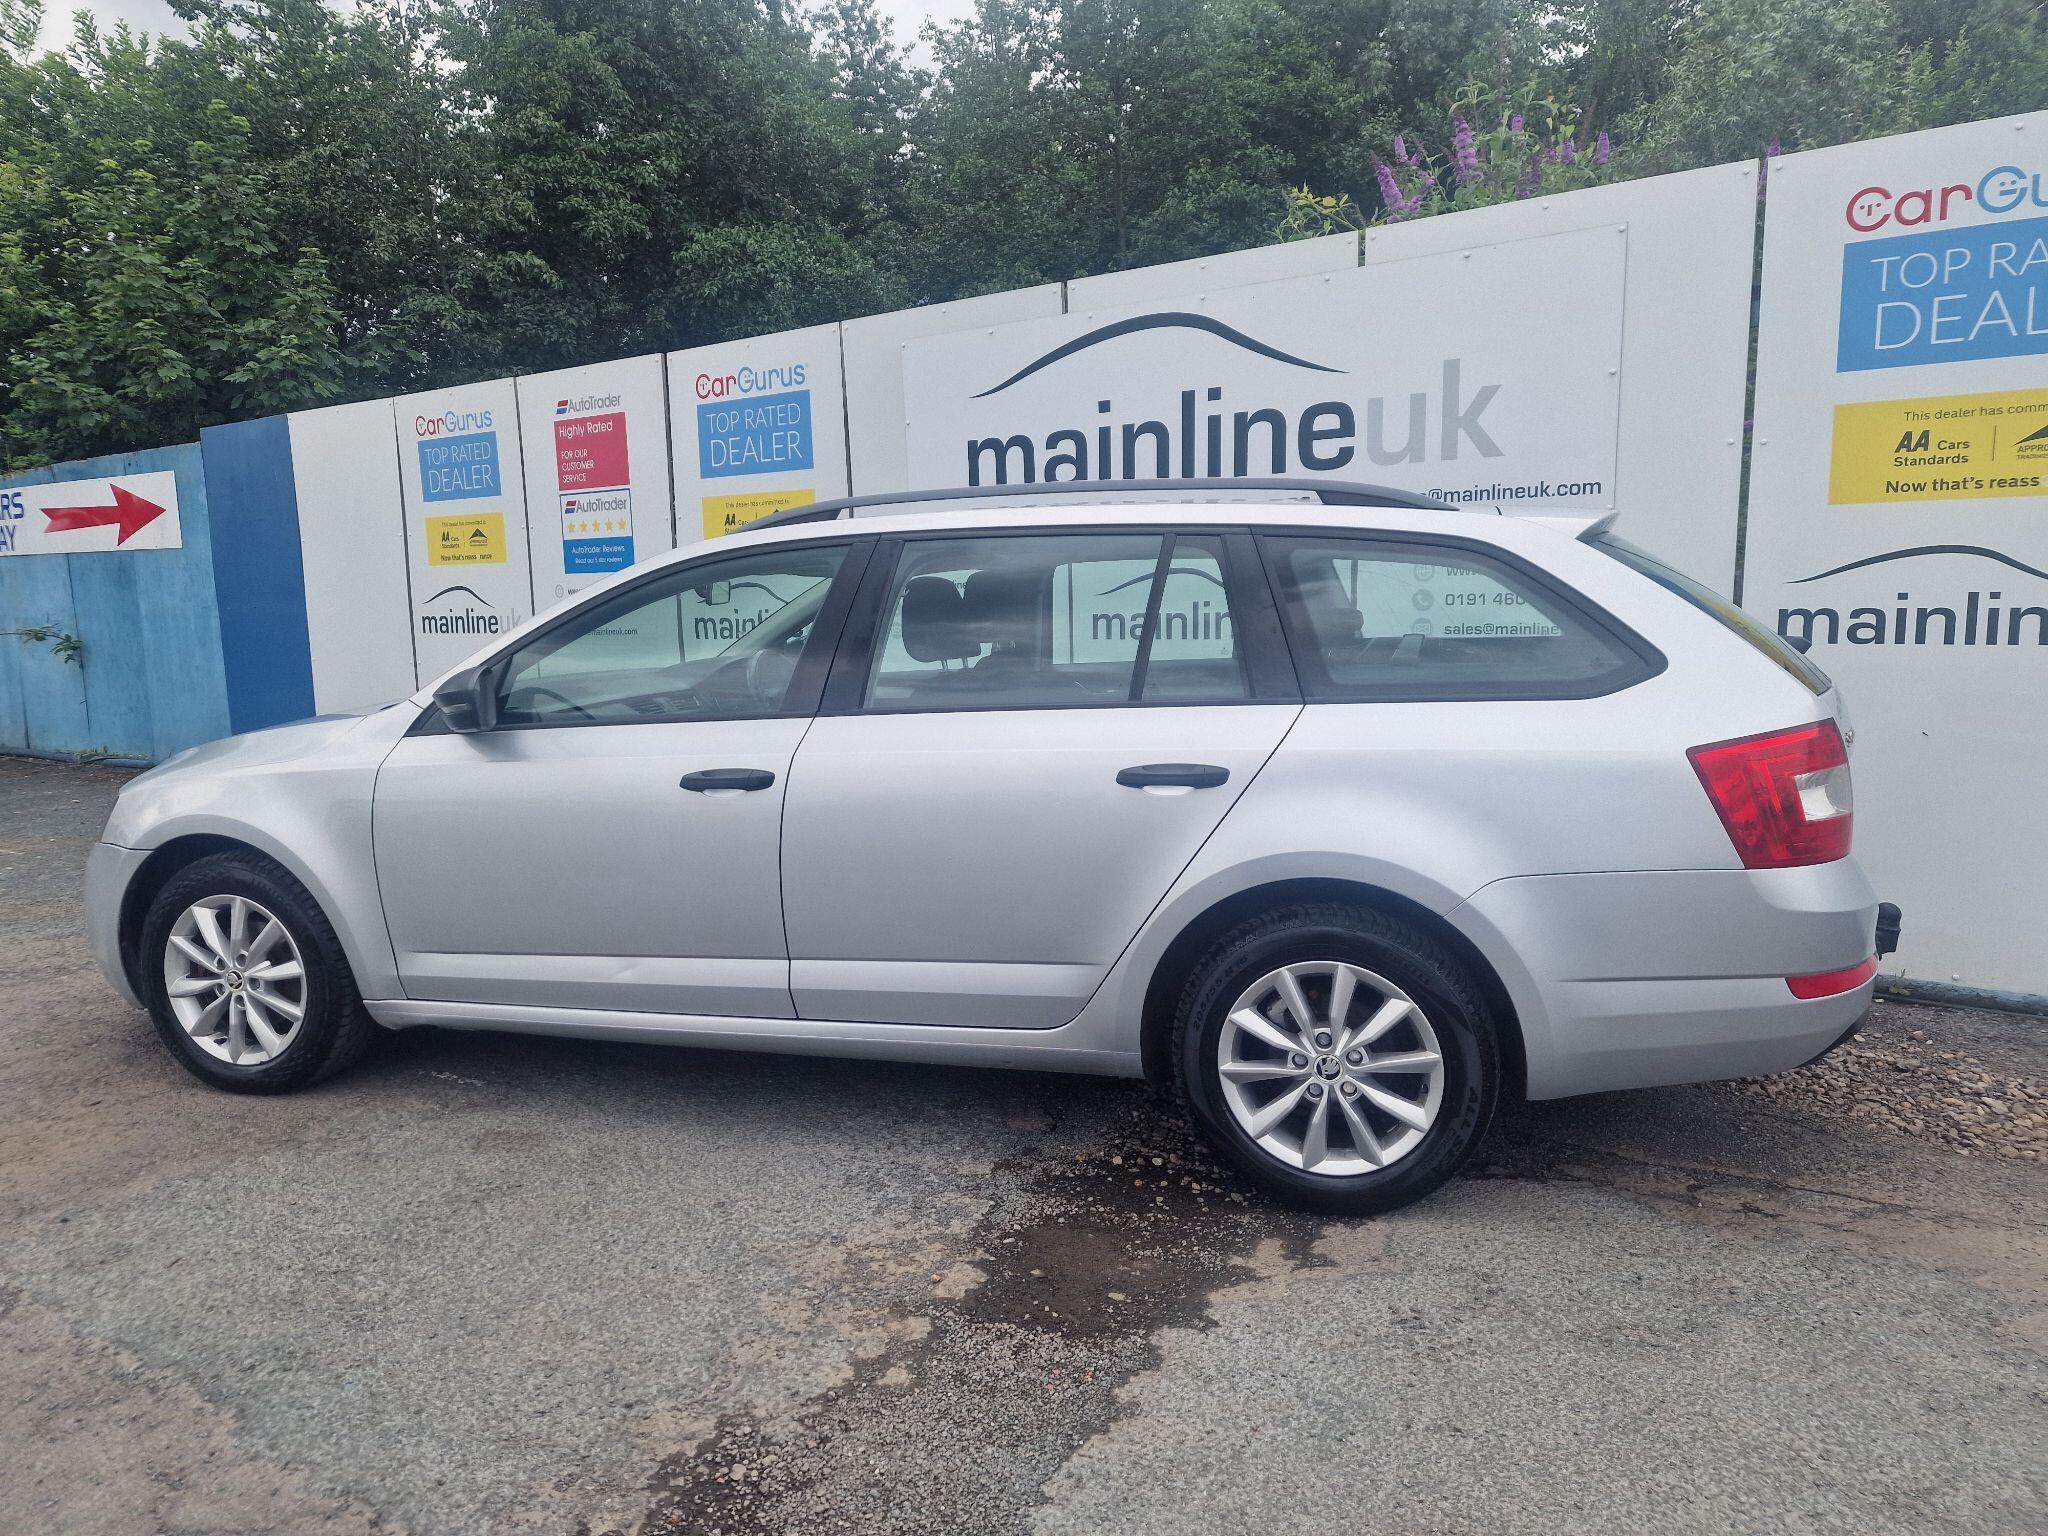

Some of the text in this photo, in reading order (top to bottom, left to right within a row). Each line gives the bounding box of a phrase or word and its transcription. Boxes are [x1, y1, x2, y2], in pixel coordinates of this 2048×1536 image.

[1870, 251, 1972, 293] TOP
[1874, 286, 2048, 350] DEAL
[695, 363, 806, 400] CarGurus
[567, 393, 621, 413] AutoTrader
[1904, 411, 1930, 421] This
[1934, 408, 1976, 420] dealer
[1979, 406, 2003, 416] has
[415, 410, 493, 437] CarGurus
[559, 420, 613, 439] Highly Rated
[706, 403, 801, 434] TOP RATED
[967, 358, 1505, 488] mainlineuk
[424, 442, 491, 465] TOP RATED
[710, 430, 803, 467] DEALER
[1894, 429, 1970, 454] AA Cars
[1894, 454, 1970, 467] Standards
[428, 464, 494, 493] DEALER
[1885, 480, 1928, 494] Now
[576, 497, 628, 514] AutoTrader
[724, 513, 736, 526] AA
[1445, 593, 1487, 606] 0191
